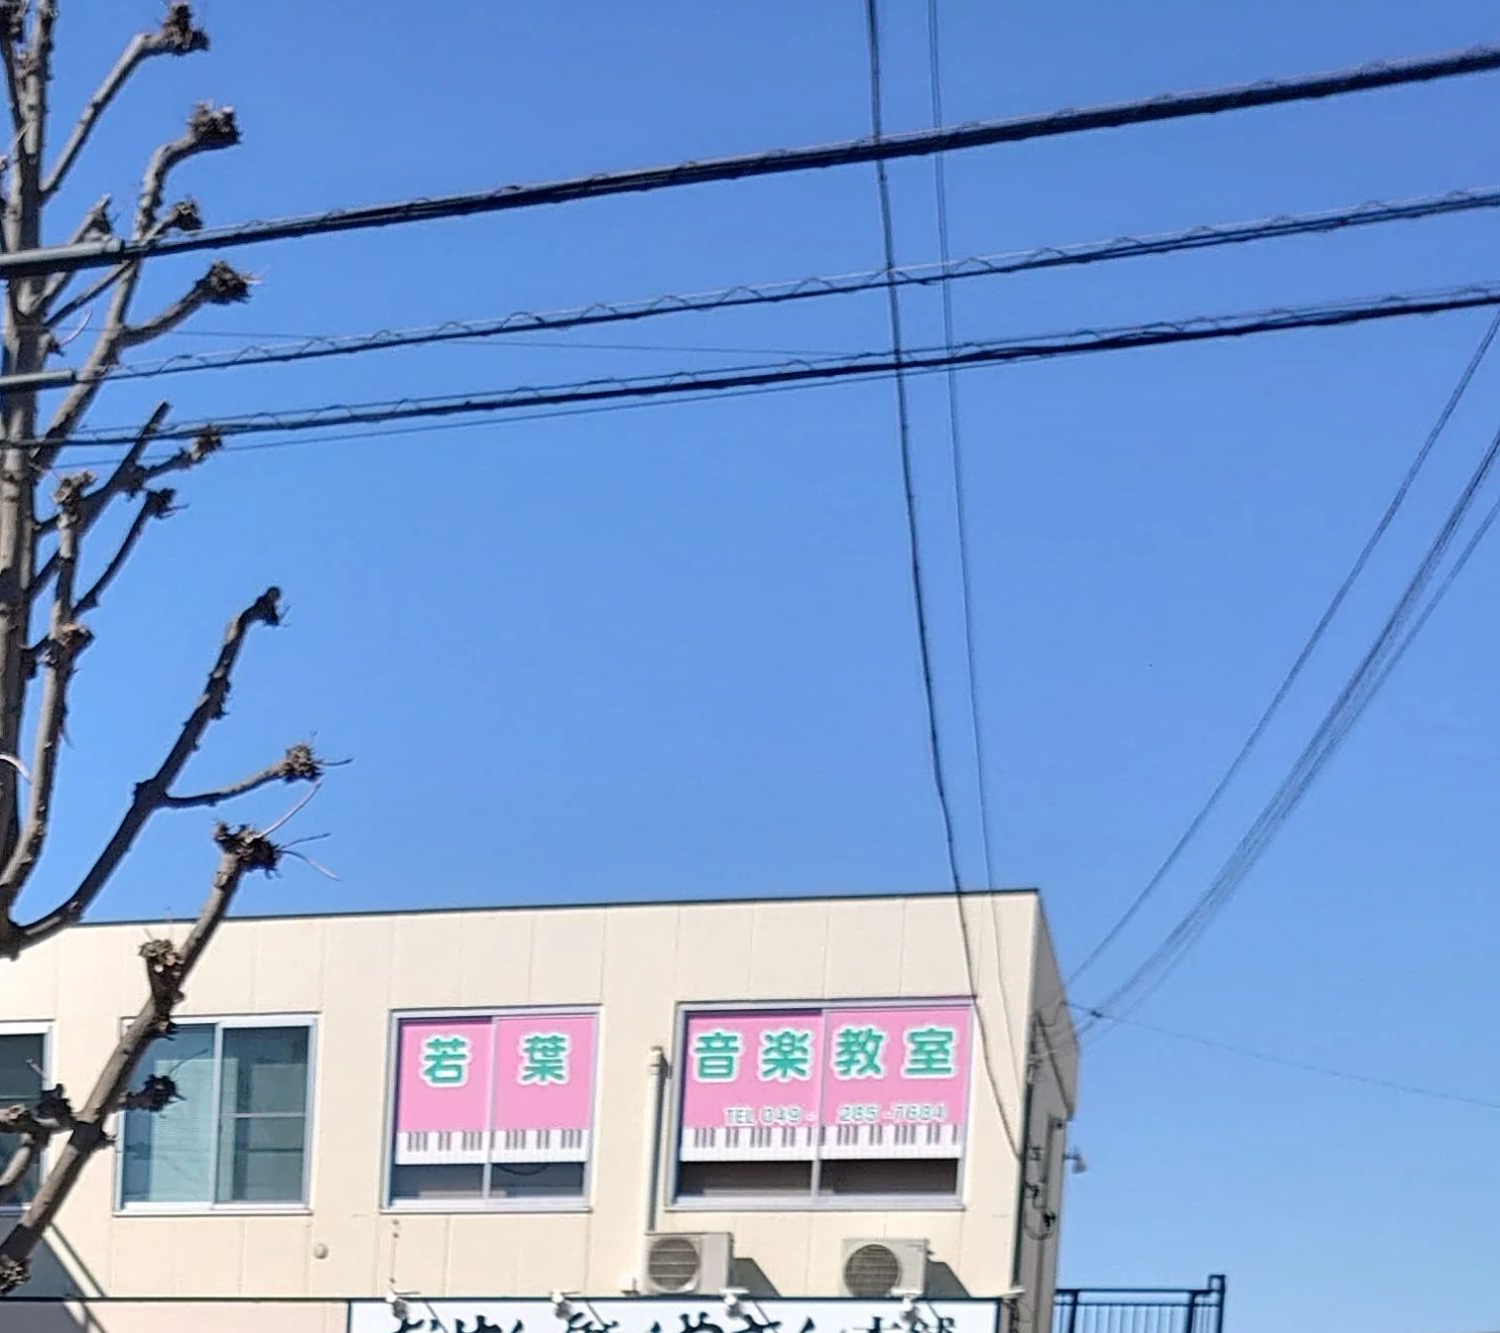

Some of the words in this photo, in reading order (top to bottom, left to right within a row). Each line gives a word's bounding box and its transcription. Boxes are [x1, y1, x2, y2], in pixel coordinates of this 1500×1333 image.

[423, 1034, 567, 1084] 若葉
[693, 1027, 954, 1079] 音楽教室
[726, 1108, 754, 1124] TEL
